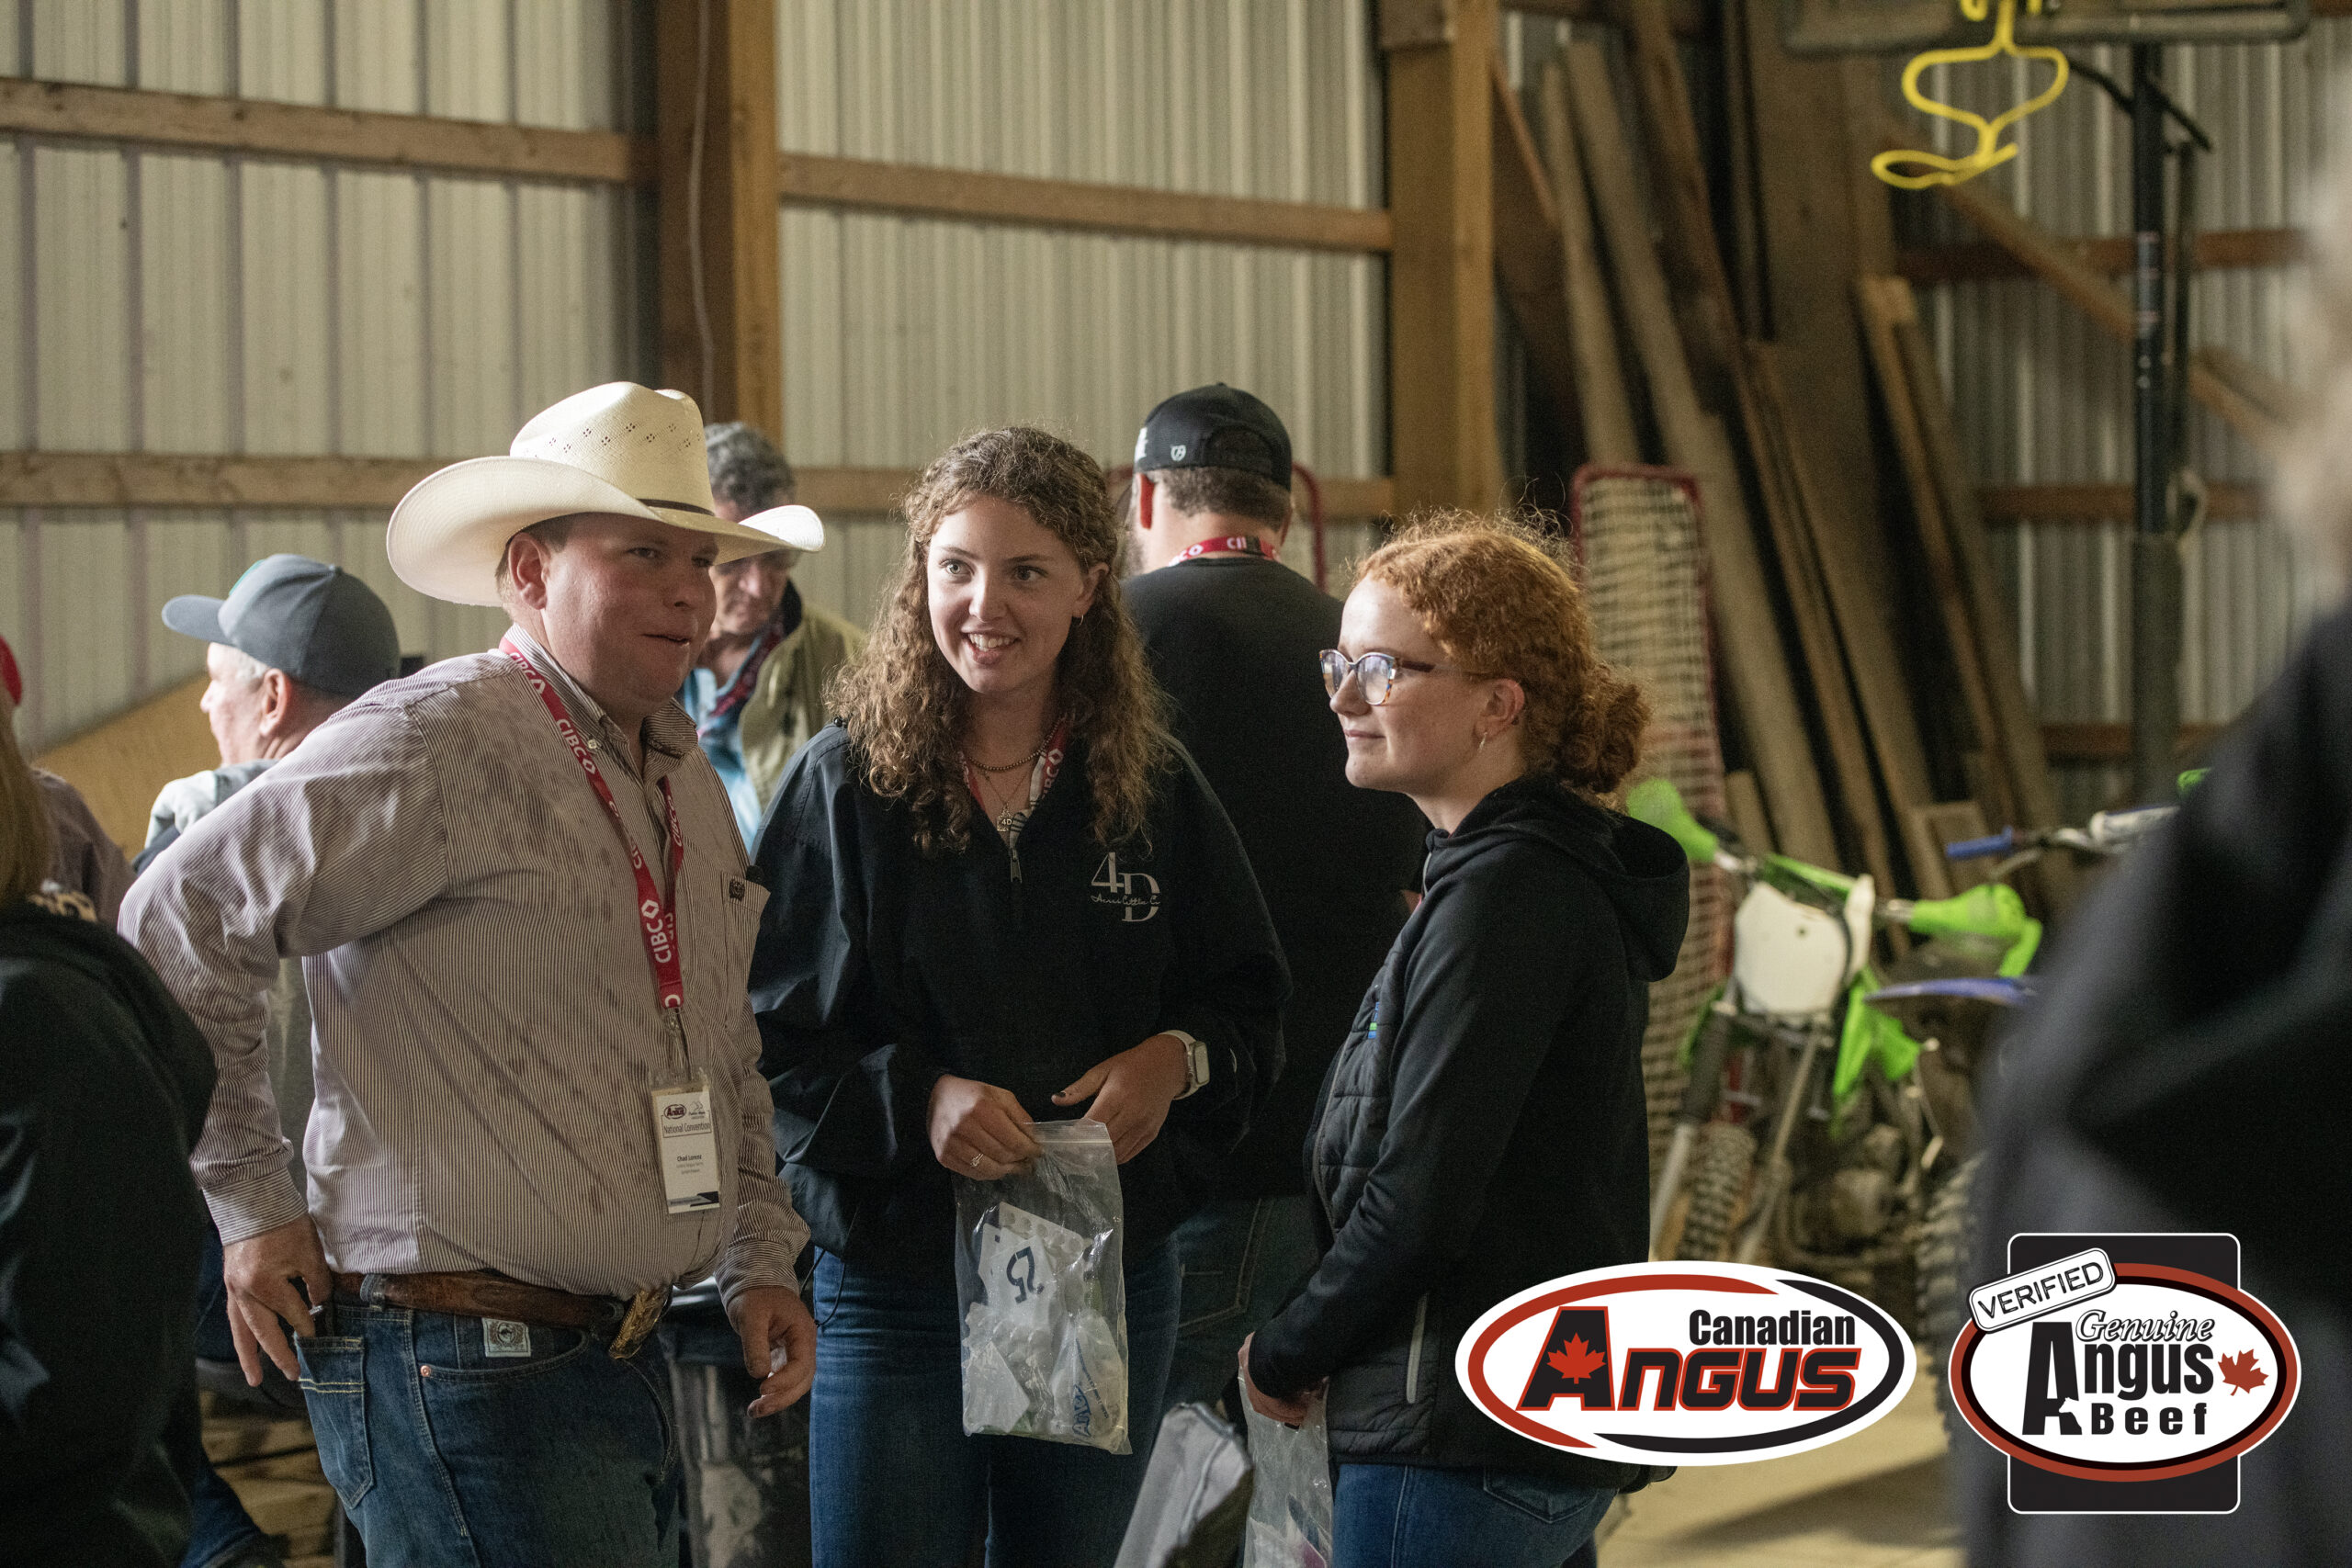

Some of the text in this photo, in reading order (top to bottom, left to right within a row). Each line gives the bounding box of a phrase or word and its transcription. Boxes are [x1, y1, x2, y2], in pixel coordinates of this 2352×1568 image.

[557, 718, 587, 758] CIBC
[669, 809, 683, 847] CIBC
[1091, 851, 1160, 922] 4D
[646, 919, 672, 964] CIBC
[664, 1122, 711, 1134] National Convention
